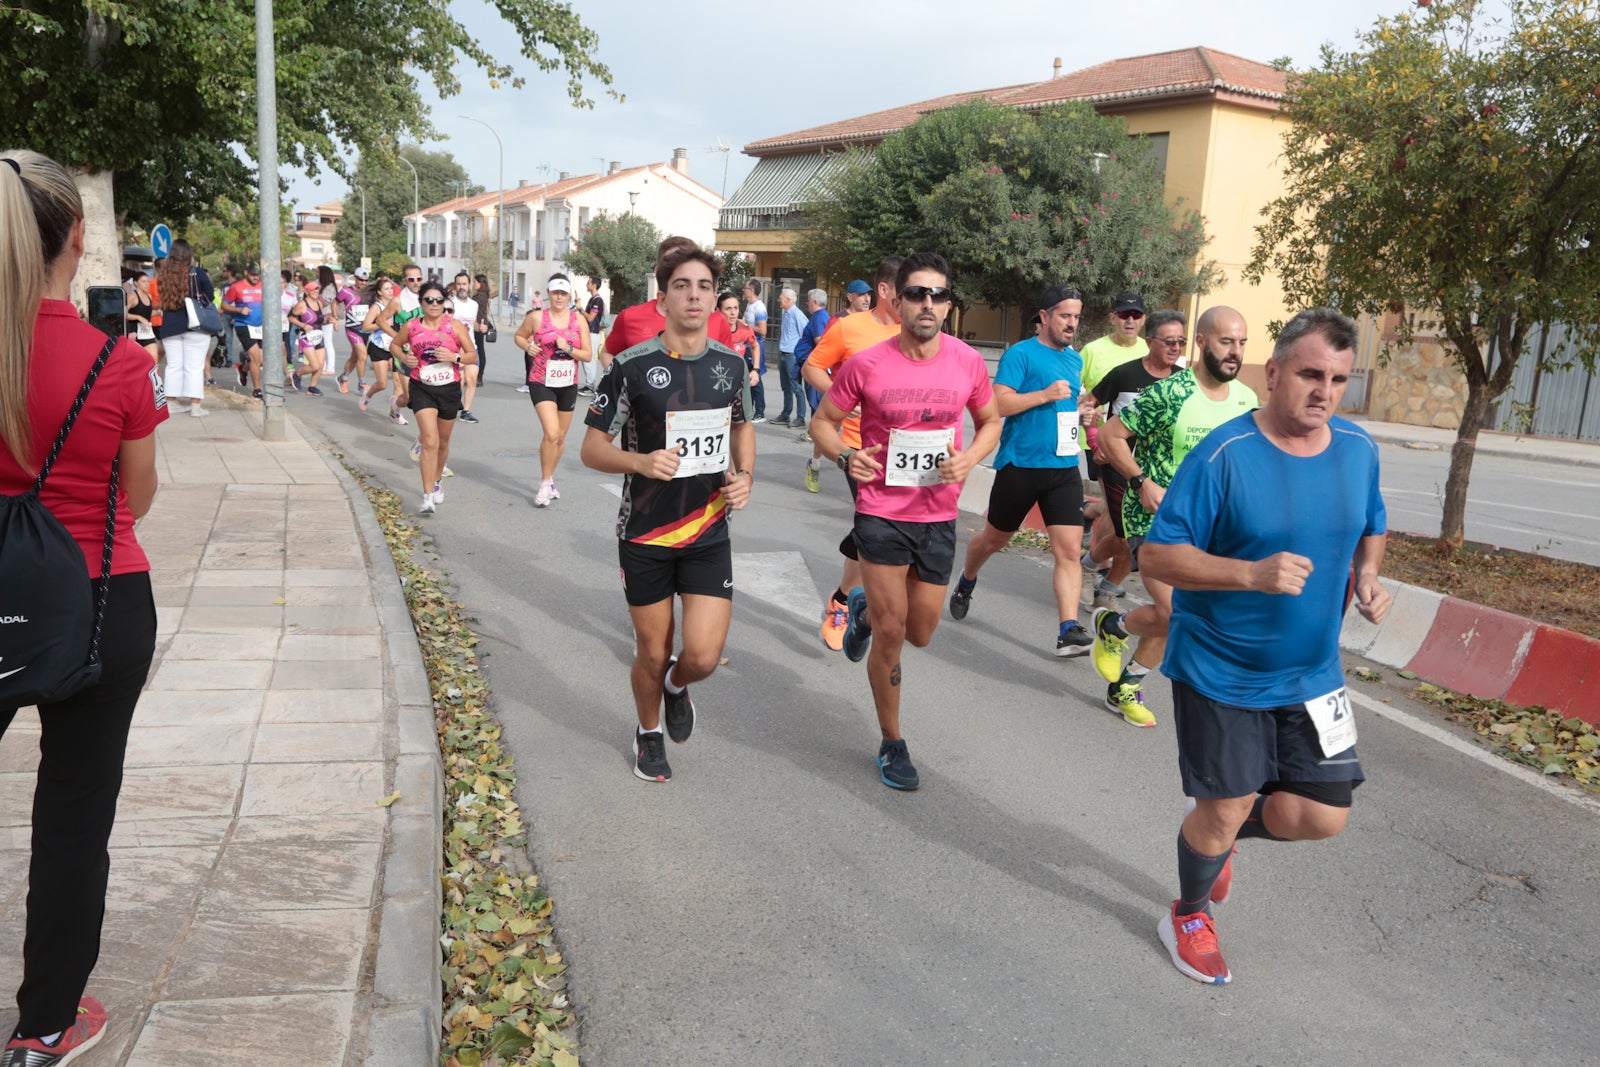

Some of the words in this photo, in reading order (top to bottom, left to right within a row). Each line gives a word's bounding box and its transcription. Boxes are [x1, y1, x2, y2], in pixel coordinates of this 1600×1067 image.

[425, 371, 450, 383] 2152
[550, 369, 572, 378] 2041
[1071, 427, 1078, 440] 9
[675, 434, 724, 457] 3137
[895, 452, 945, 470] 3136
